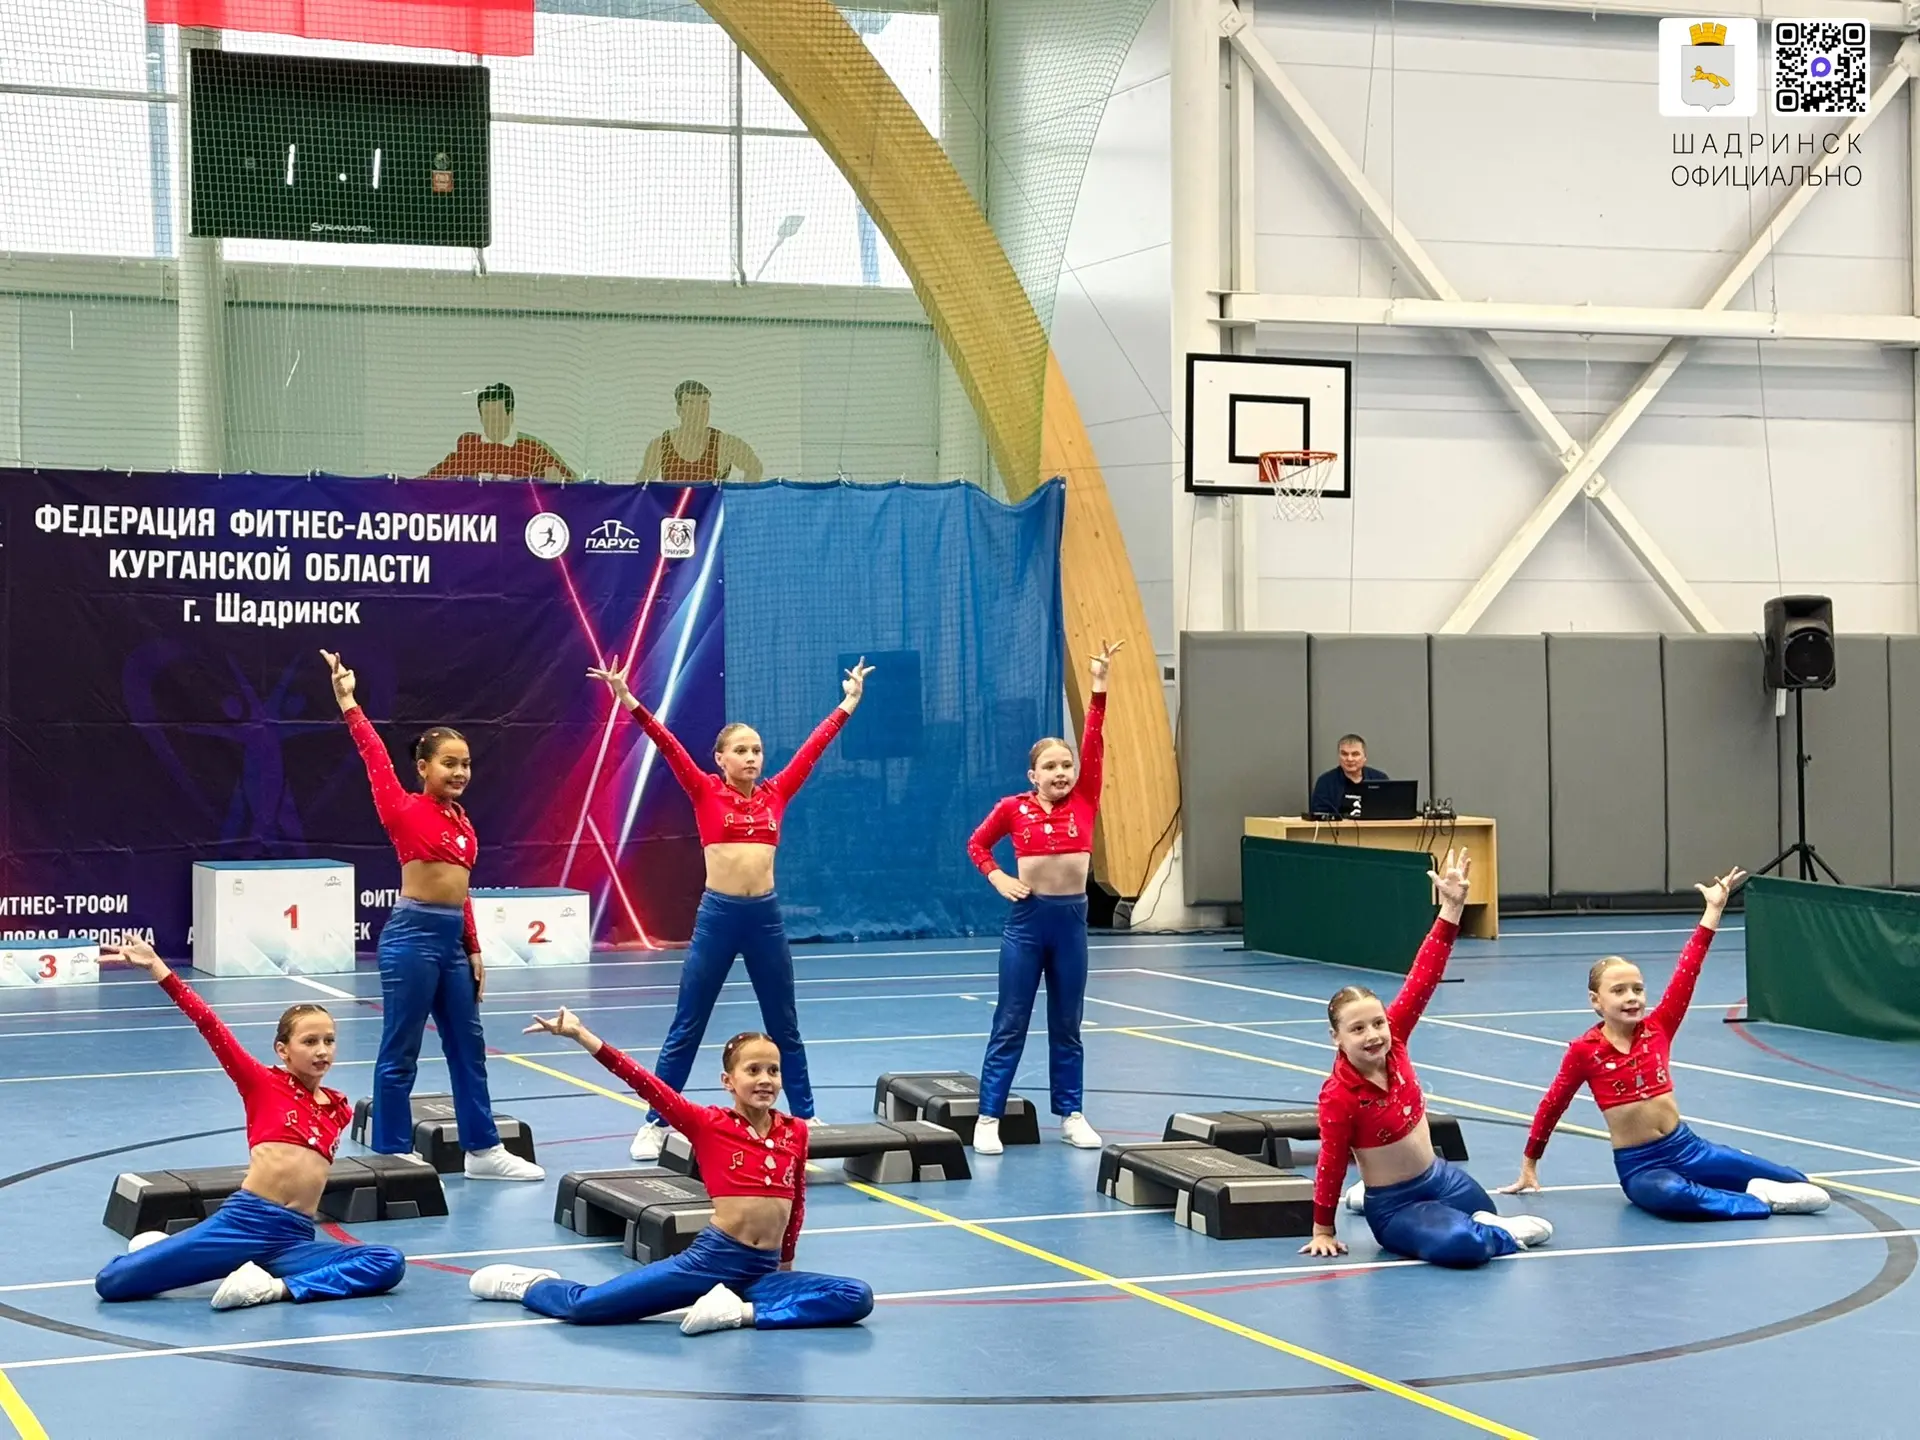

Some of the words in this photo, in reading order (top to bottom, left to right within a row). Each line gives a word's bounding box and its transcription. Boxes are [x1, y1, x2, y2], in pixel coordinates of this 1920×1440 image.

[34, 503, 215, 540] ФЕДЕРАЦИЯ
[230, 508, 497, 542] ФИТНЕС-АЭРОБИКИ
[585, 538, 640, 549] ПАРУС
[109, 545, 291, 581] КУРГАНСКОЙ
[305, 552, 430, 583] ОБЛАСТИ
[184, 599, 201, 622] г.
[215, 592, 361, 629] Шадринск
[283, 904, 300, 930] 1
[527, 920, 547, 944] 2
[38, 954, 57, 978] 3
